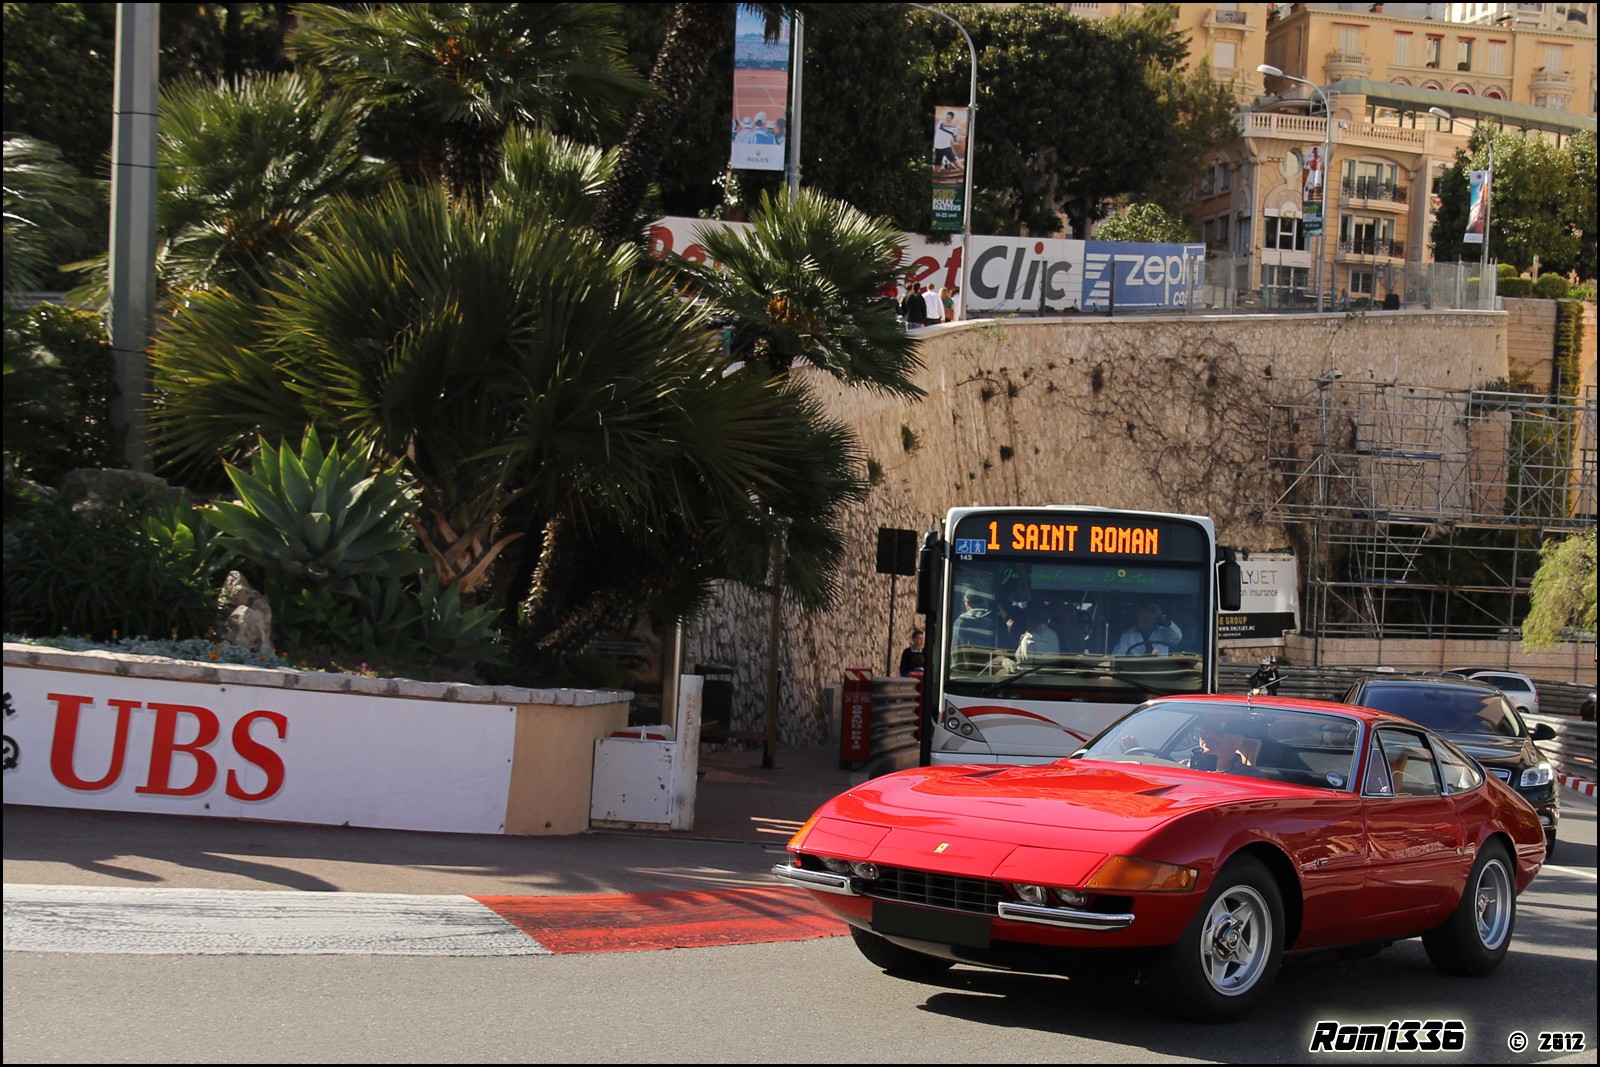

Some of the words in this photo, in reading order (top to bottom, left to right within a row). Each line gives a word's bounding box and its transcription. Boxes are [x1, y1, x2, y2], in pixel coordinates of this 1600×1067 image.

[987, 521, 1000, 550] 1
[1012, 523, 1078, 552] SAINT
[1090, 526, 1159, 555] ROMAN
[1240, 570, 1277, 584] LYJET
[1250, 588, 1278, 597] insurance
[1226, 617, 1247, 625] GROUP
[852, 705, 863, 729] GRAND
[47, 693, 288, 801] UBS
